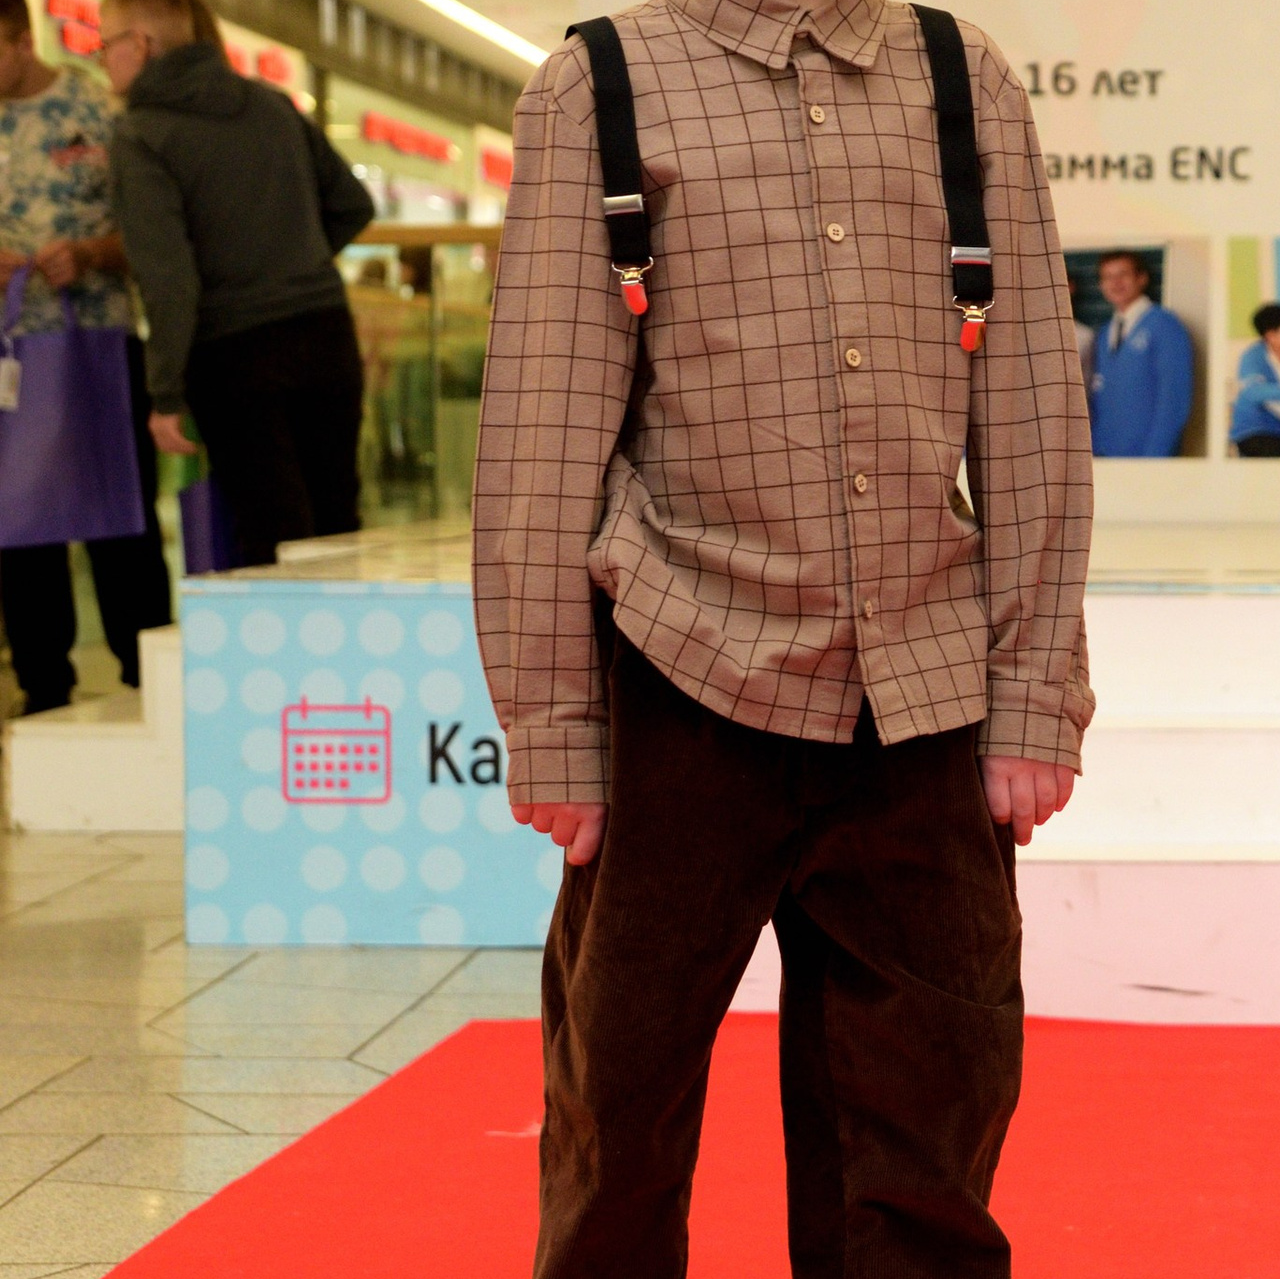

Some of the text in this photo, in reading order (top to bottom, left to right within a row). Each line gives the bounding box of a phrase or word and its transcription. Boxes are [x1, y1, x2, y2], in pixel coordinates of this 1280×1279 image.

[1091, 67, 1164, 97] лет
[1044, 145, 1251, 182] амма ENC
[428, 721, 503, 786] Ка
